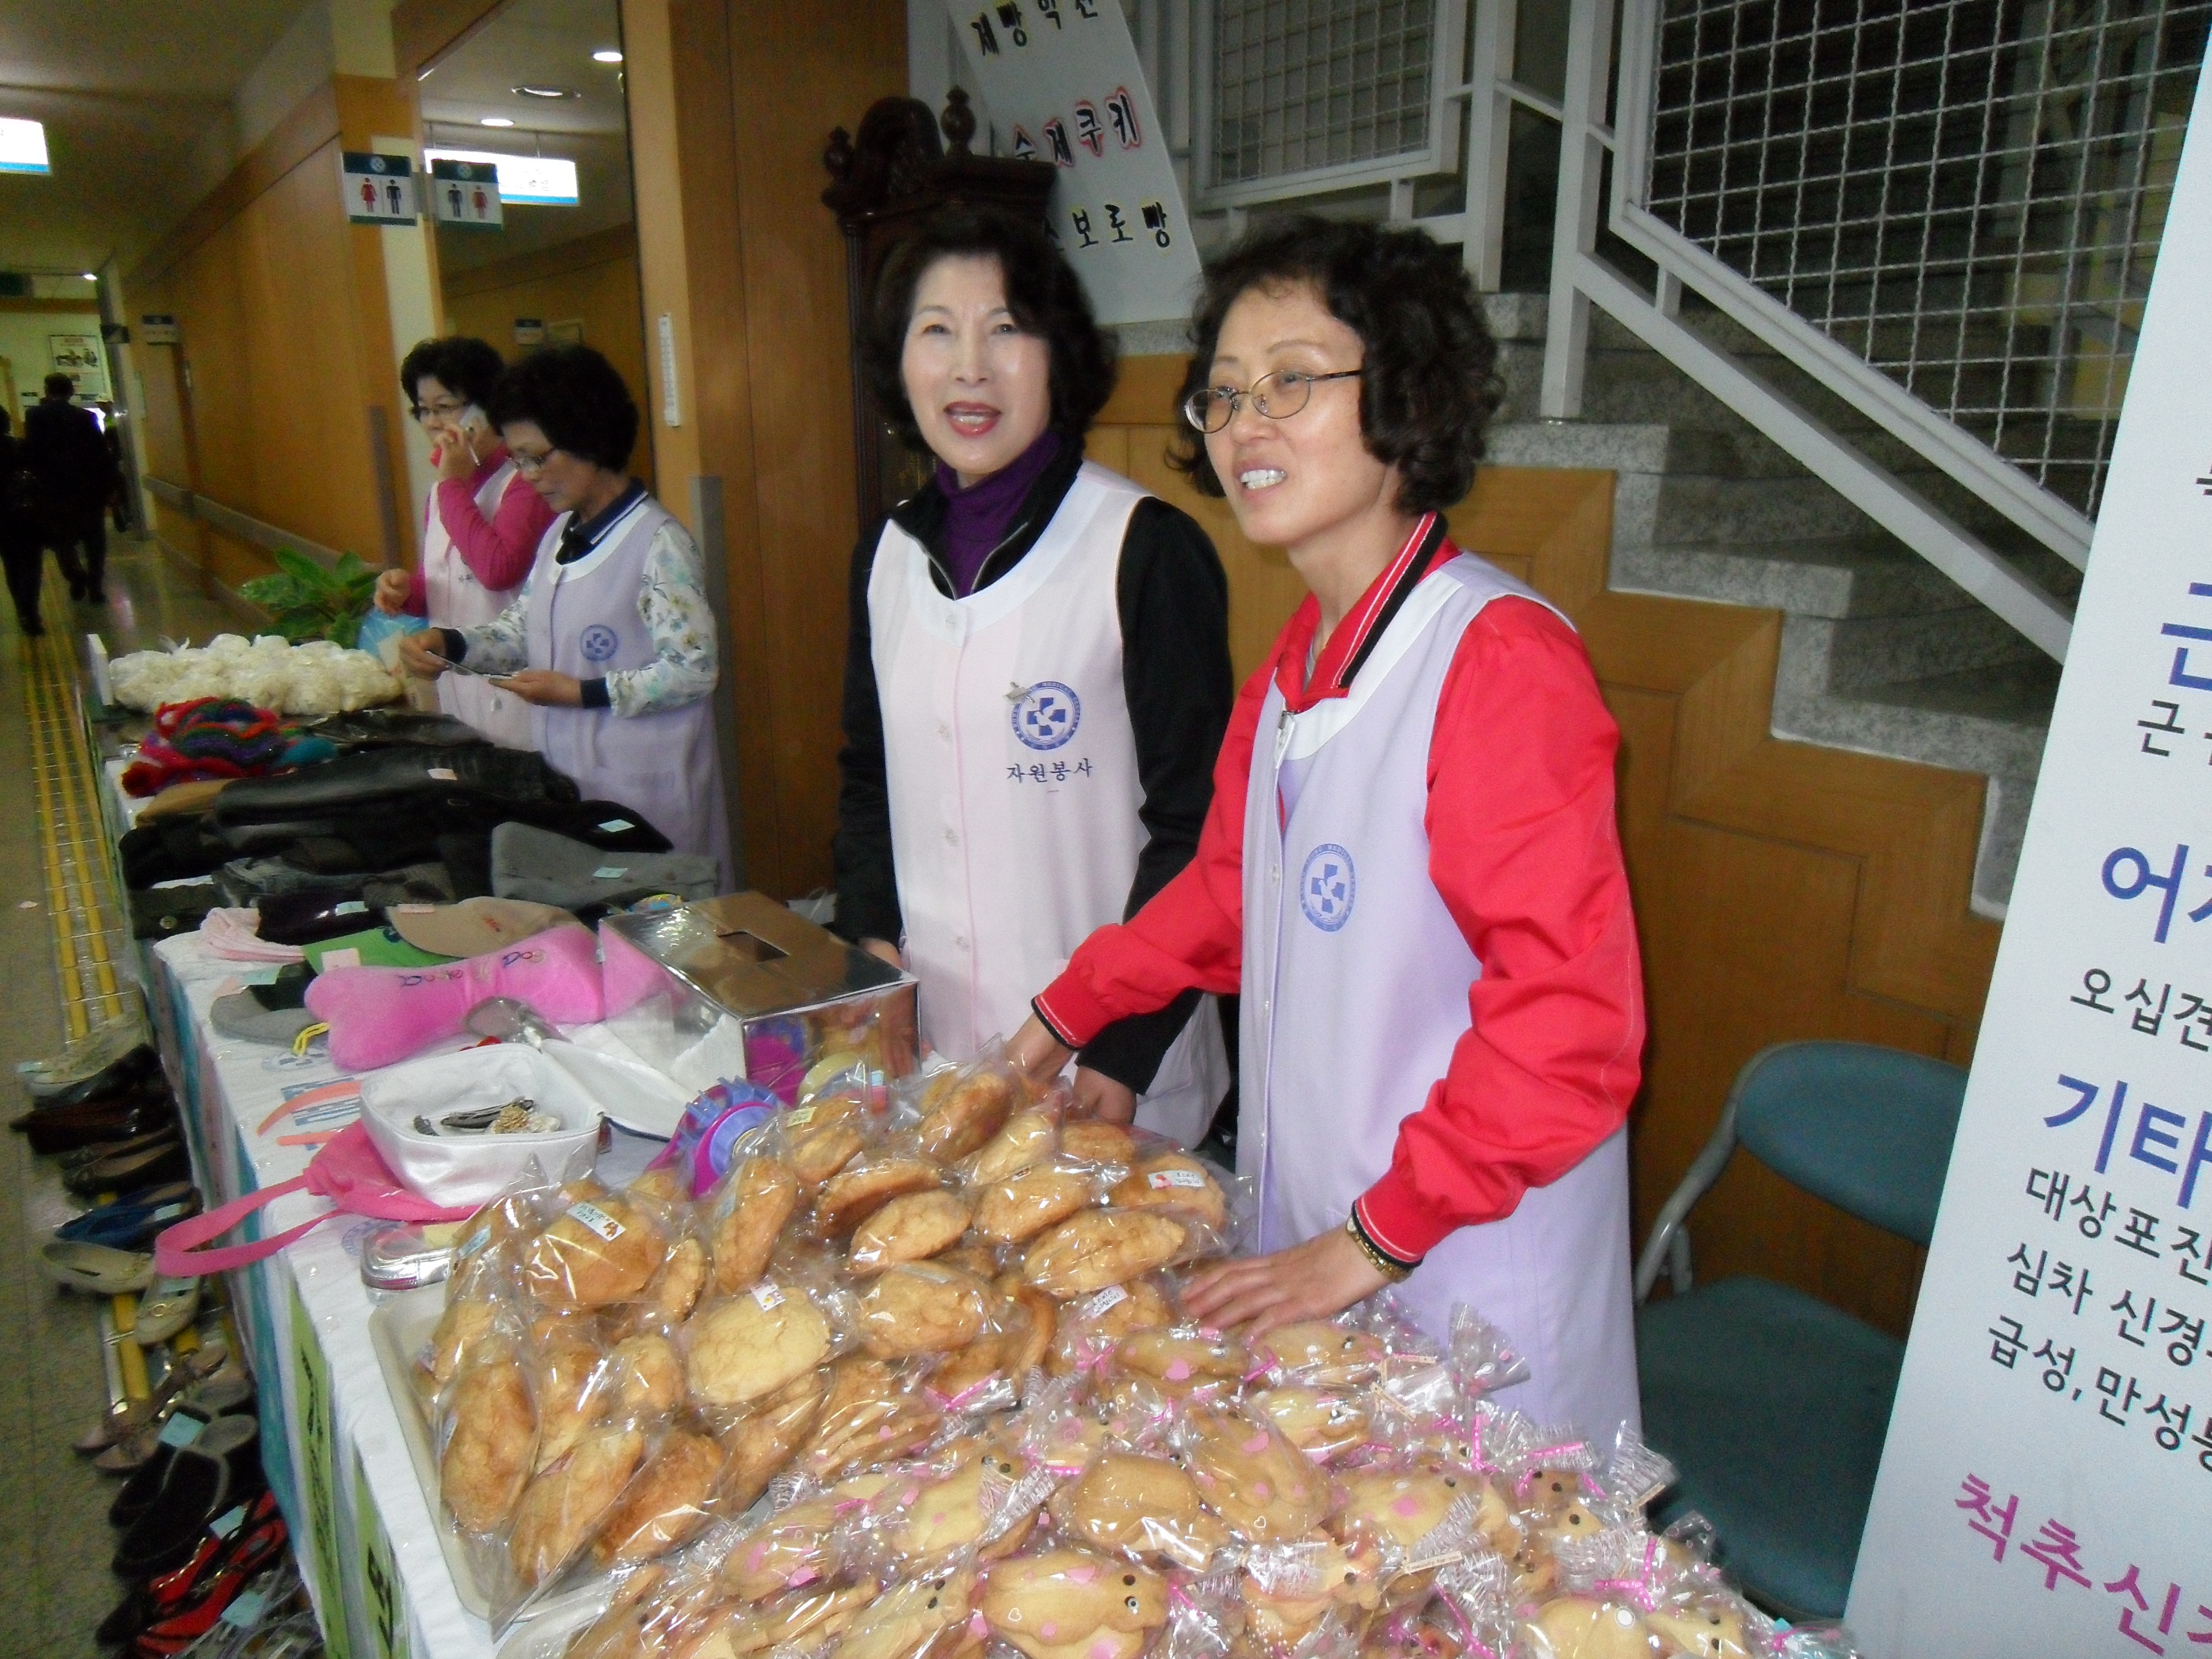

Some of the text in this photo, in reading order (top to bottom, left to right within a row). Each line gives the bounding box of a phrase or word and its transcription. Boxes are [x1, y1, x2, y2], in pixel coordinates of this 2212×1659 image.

[1006, 758, 1093, 783] 자원봉사
[2026, 1168, 2212, 1286] 대상포진
[2007, 1243, 2212, 1366] 심차 신경
